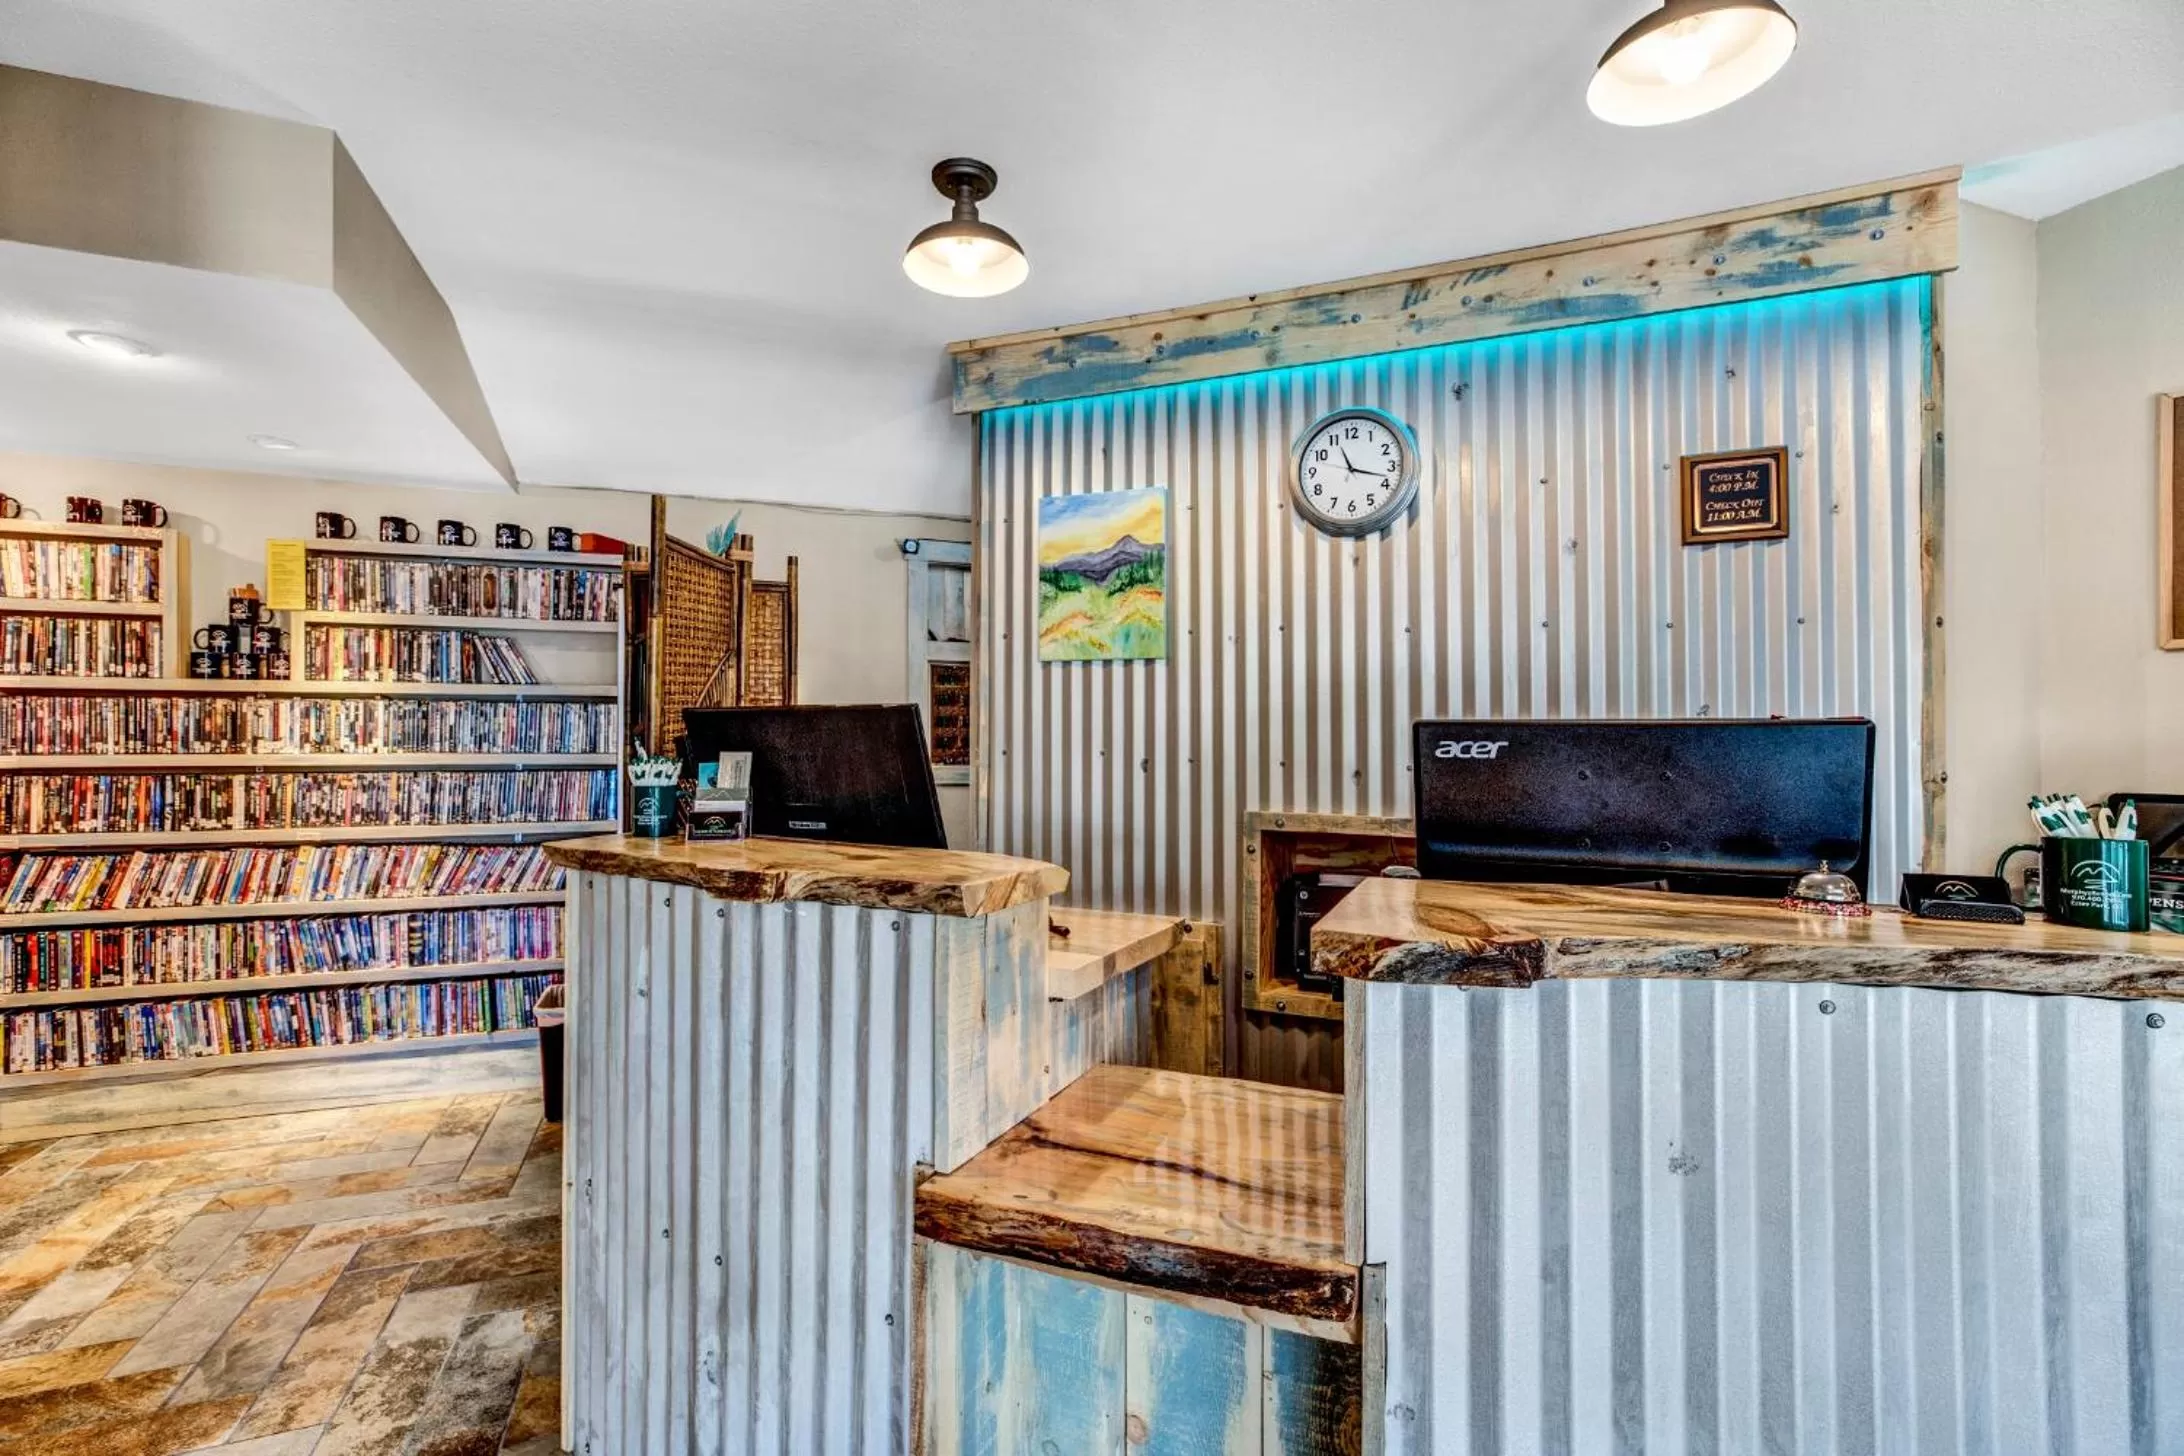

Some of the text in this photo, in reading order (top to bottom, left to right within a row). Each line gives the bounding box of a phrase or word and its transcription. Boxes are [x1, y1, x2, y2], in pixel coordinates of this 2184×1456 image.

[1329, 434, 1339, 446] 11
[1345, 427, 1359, 440] 12
[1368, 430, 1373, 442] 1
[1315, 449, 1328, 462] 10
[1381, 443, 1390, 456] 2
[1387, 460, 1396, 472] 3
[1308, 467, 1317, 479] 9
[1314, 483, 1322, 496] 8
[1380, 478, 1390, 490] 4
[1330, 497, 1338, 509] 7
[1366, 493, 1375, 506] 5
[1347, 500, 1356, 513] 6
[1435, 741, 1509, 759] acer
